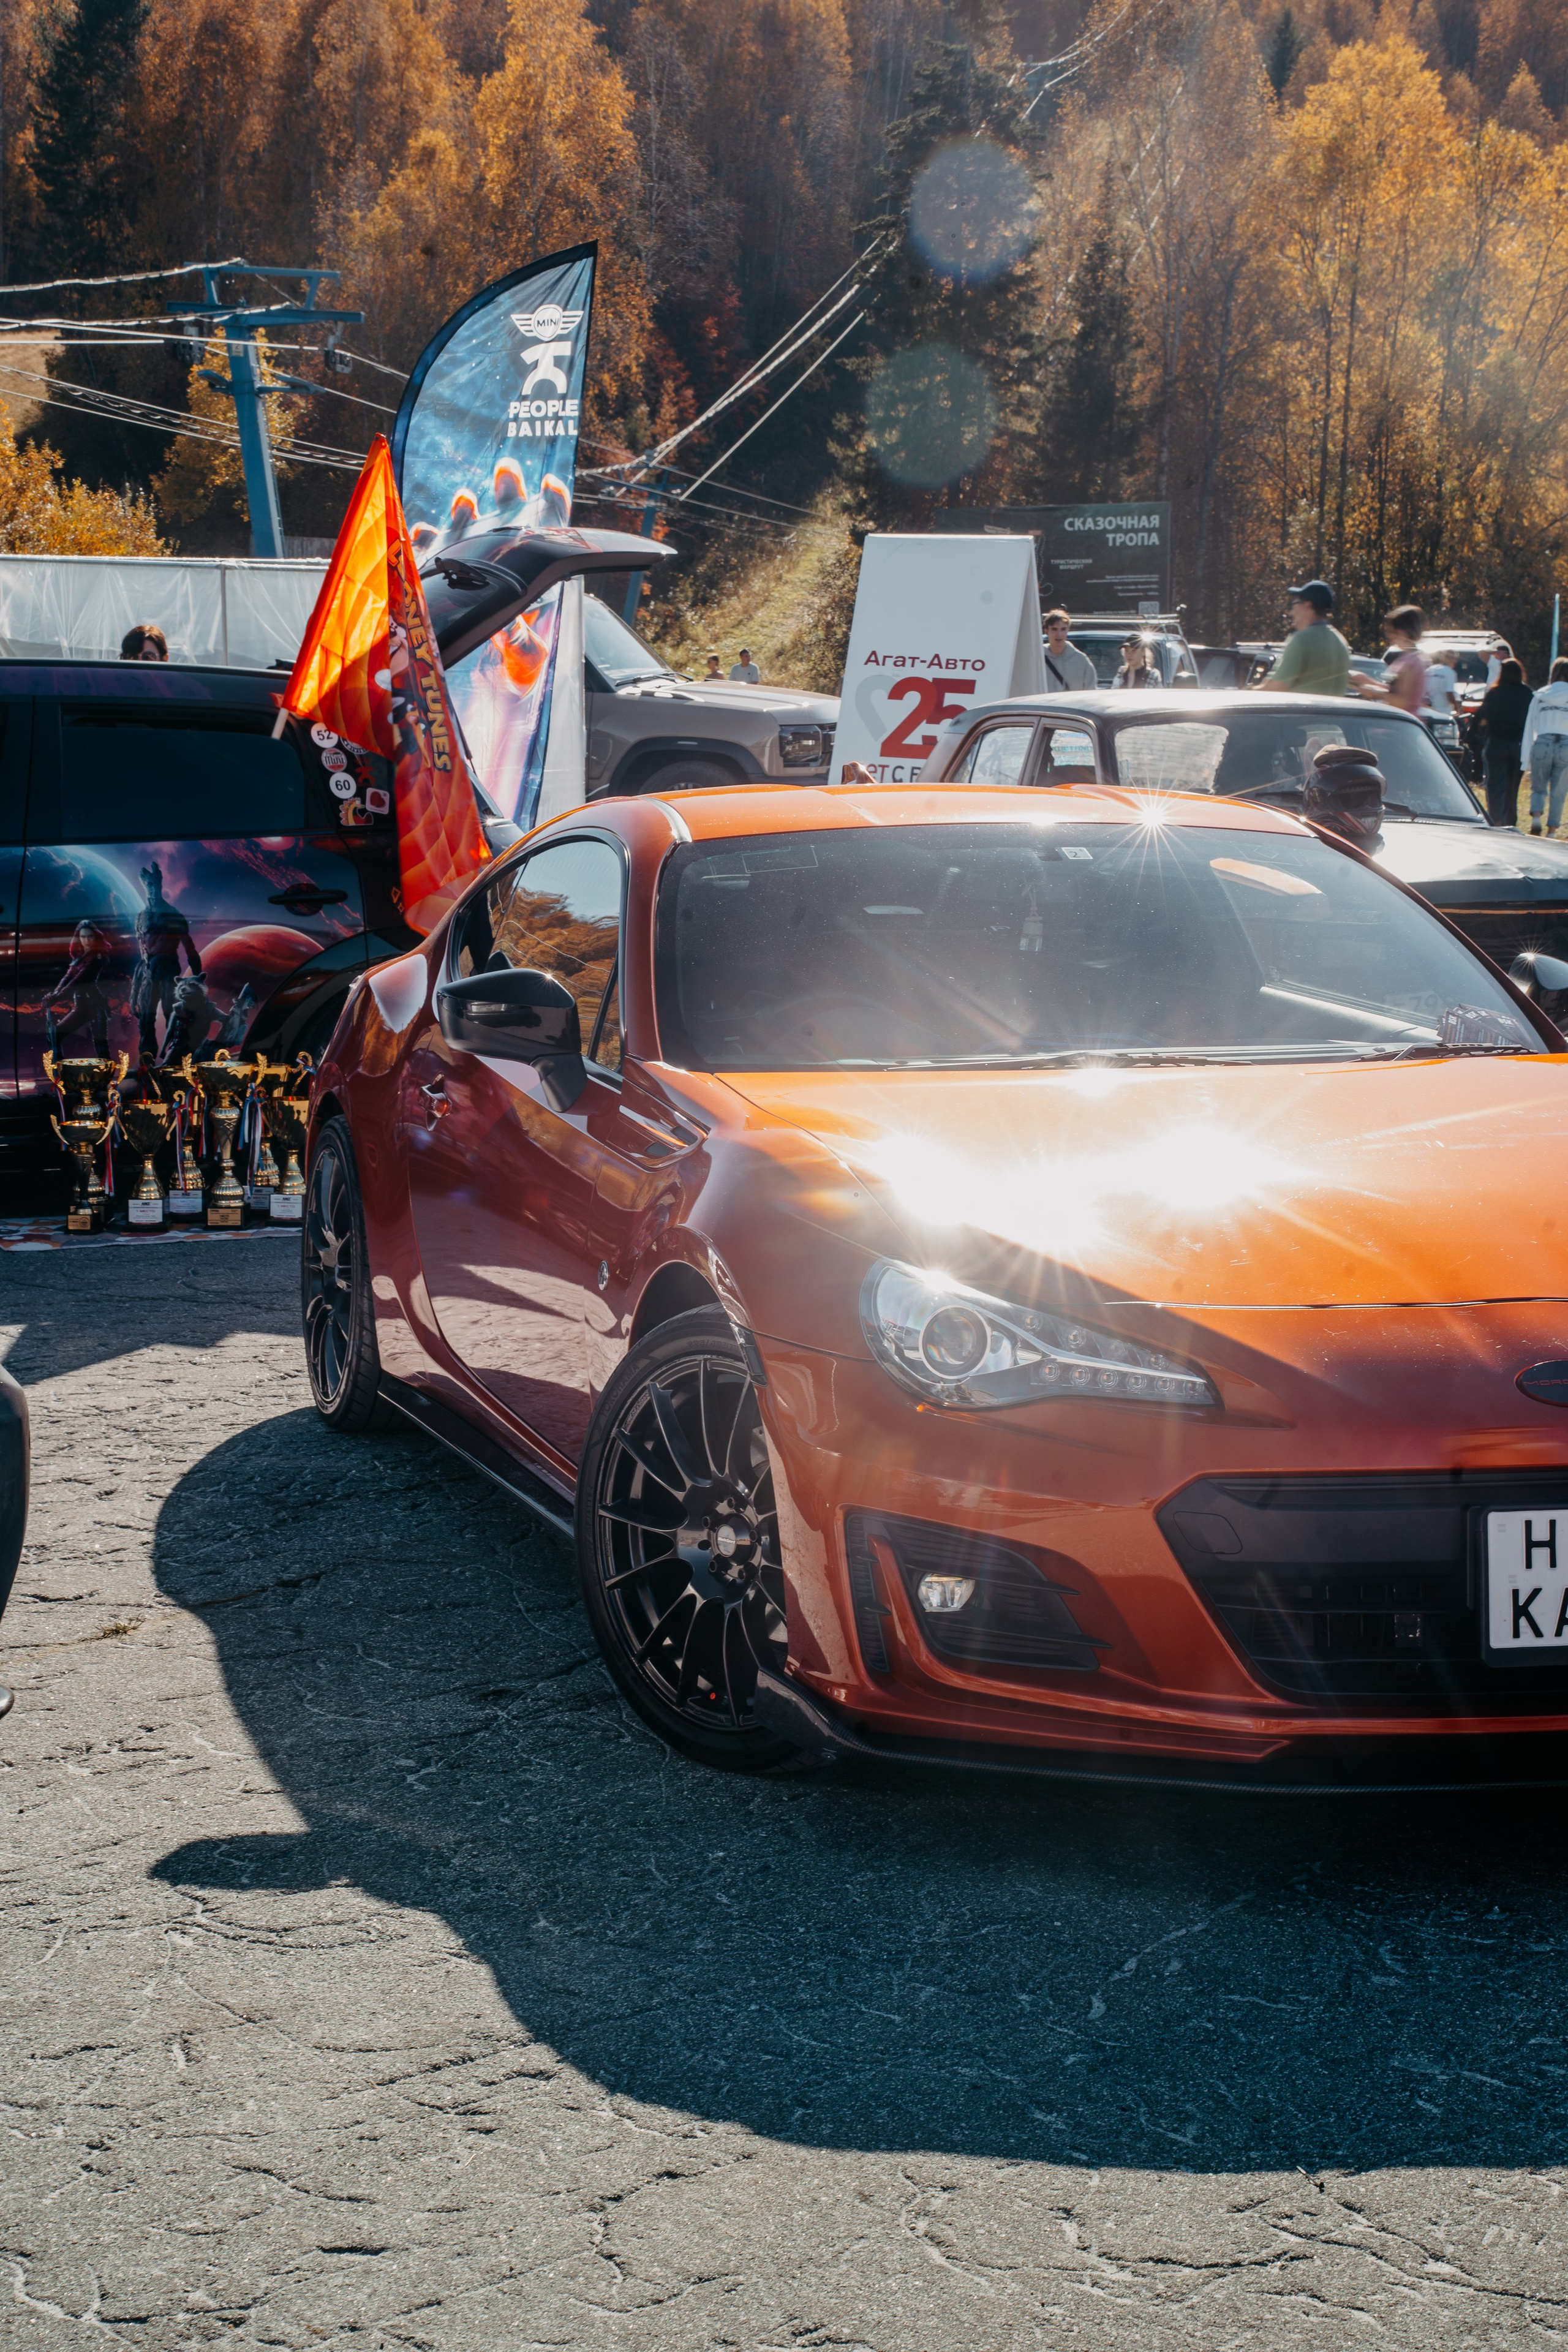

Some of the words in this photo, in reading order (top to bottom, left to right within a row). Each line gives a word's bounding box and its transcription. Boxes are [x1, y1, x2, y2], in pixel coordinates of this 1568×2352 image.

[537, 318, 559, 326] MINI
[508, 399, 579, 418] PEOPLE
[507, 420, 578, 437] BAIKAL
[1064, 514, 1160, 531] СКАЗОЧНАЯ
[1106, 532, 1160, 547] ТРОПА
[864, 650, 986, 671] Агат-Авто
[421, 670, 452, 771] TUNES
[880, 676, 977, 760] 25
[317, 729, 333, 741] 52
[335, 779, 351, 791] 60
[600, 1362, 640, 1418] YOKOHAMA
